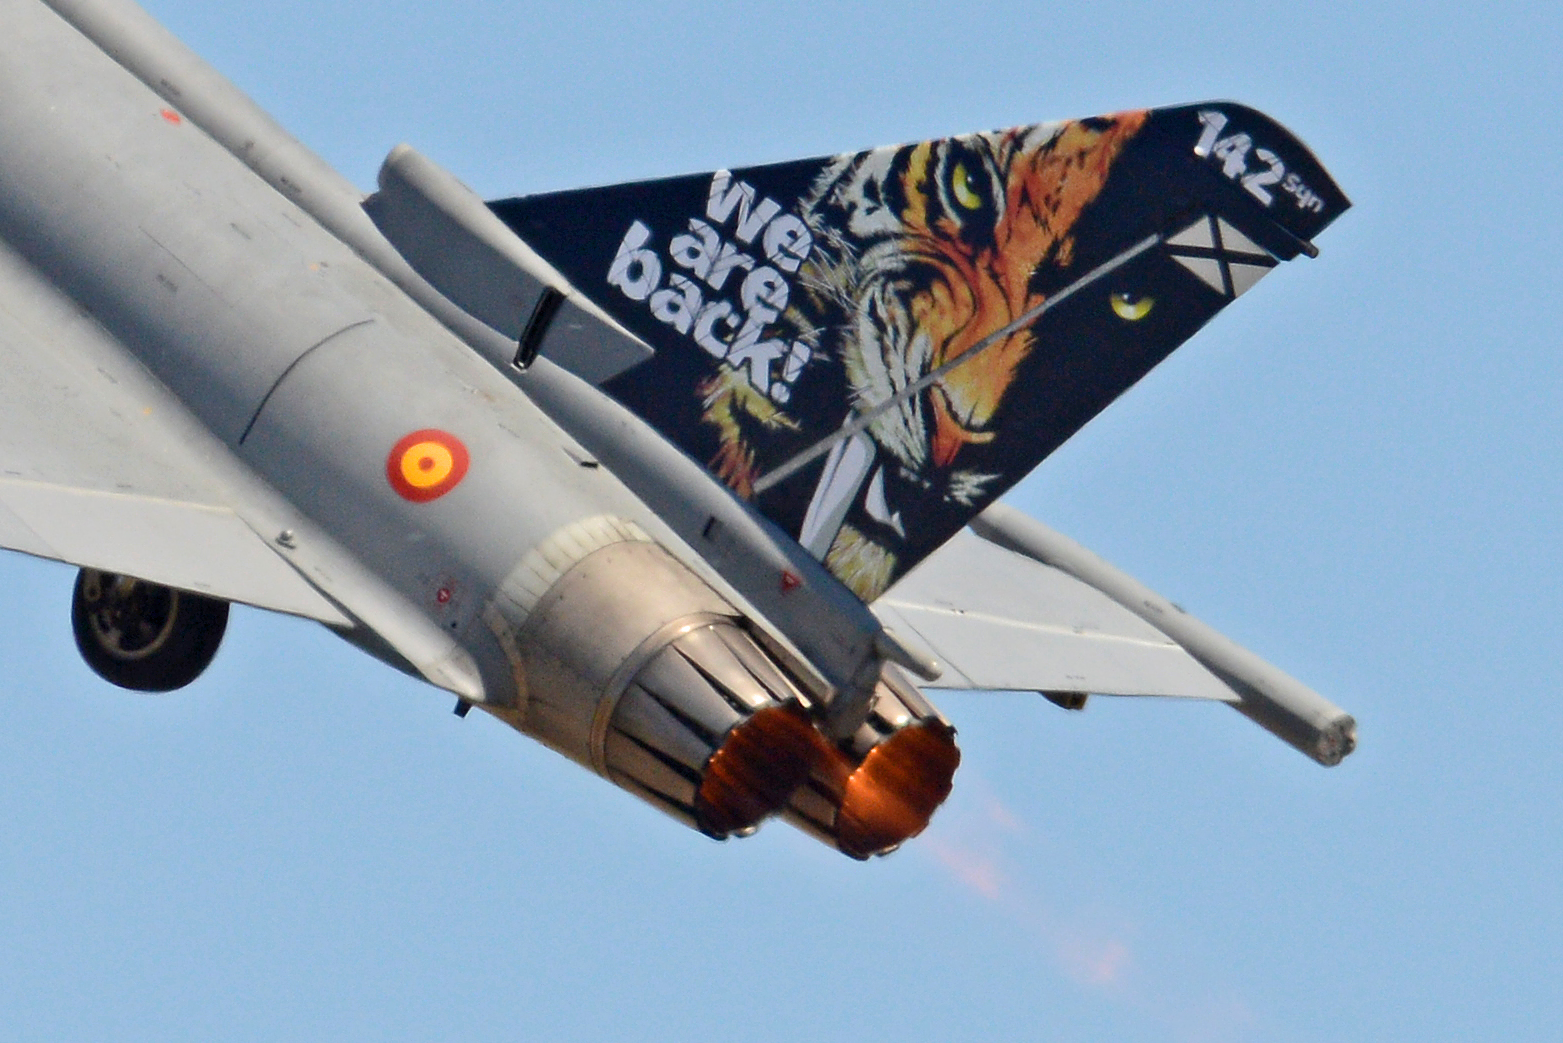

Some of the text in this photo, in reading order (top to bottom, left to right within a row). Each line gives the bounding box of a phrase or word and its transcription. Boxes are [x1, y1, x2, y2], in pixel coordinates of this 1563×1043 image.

[1193, 111, 1285, 207] 142
[669, 217, 790, 325] are
[705, 168, 814, 273] We
[606, 219, 811, 404] back!
